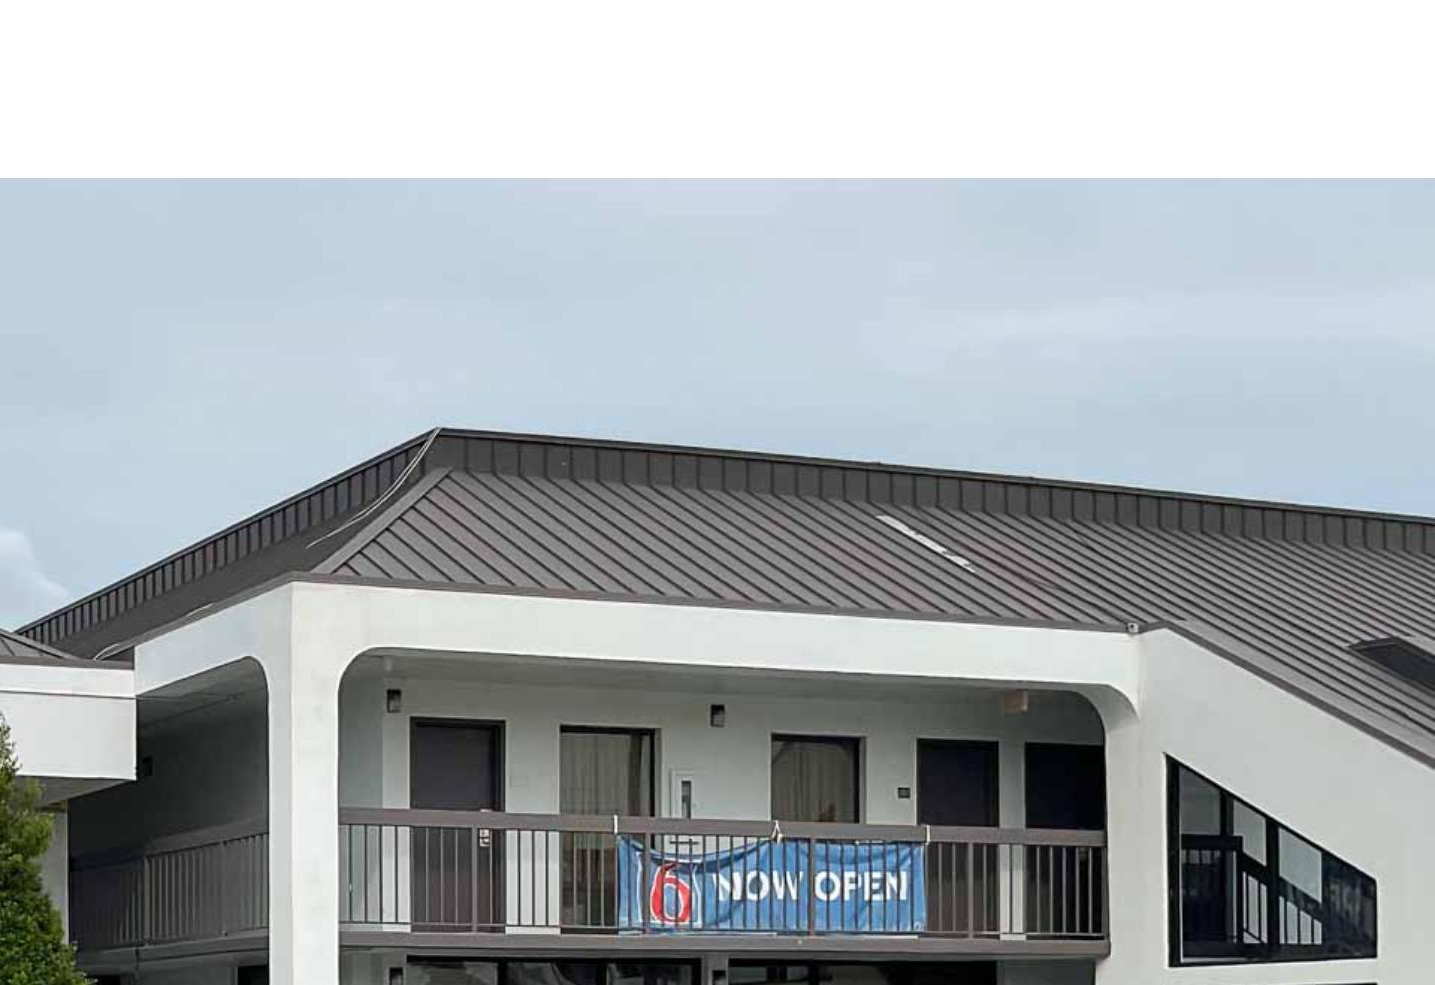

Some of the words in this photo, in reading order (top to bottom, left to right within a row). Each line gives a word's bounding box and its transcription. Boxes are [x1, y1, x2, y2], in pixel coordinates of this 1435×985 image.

[650, 862, 691, 925] 6
[713, 870, 803, 902] NOW
[814, 870, 907, 902] OPEN
